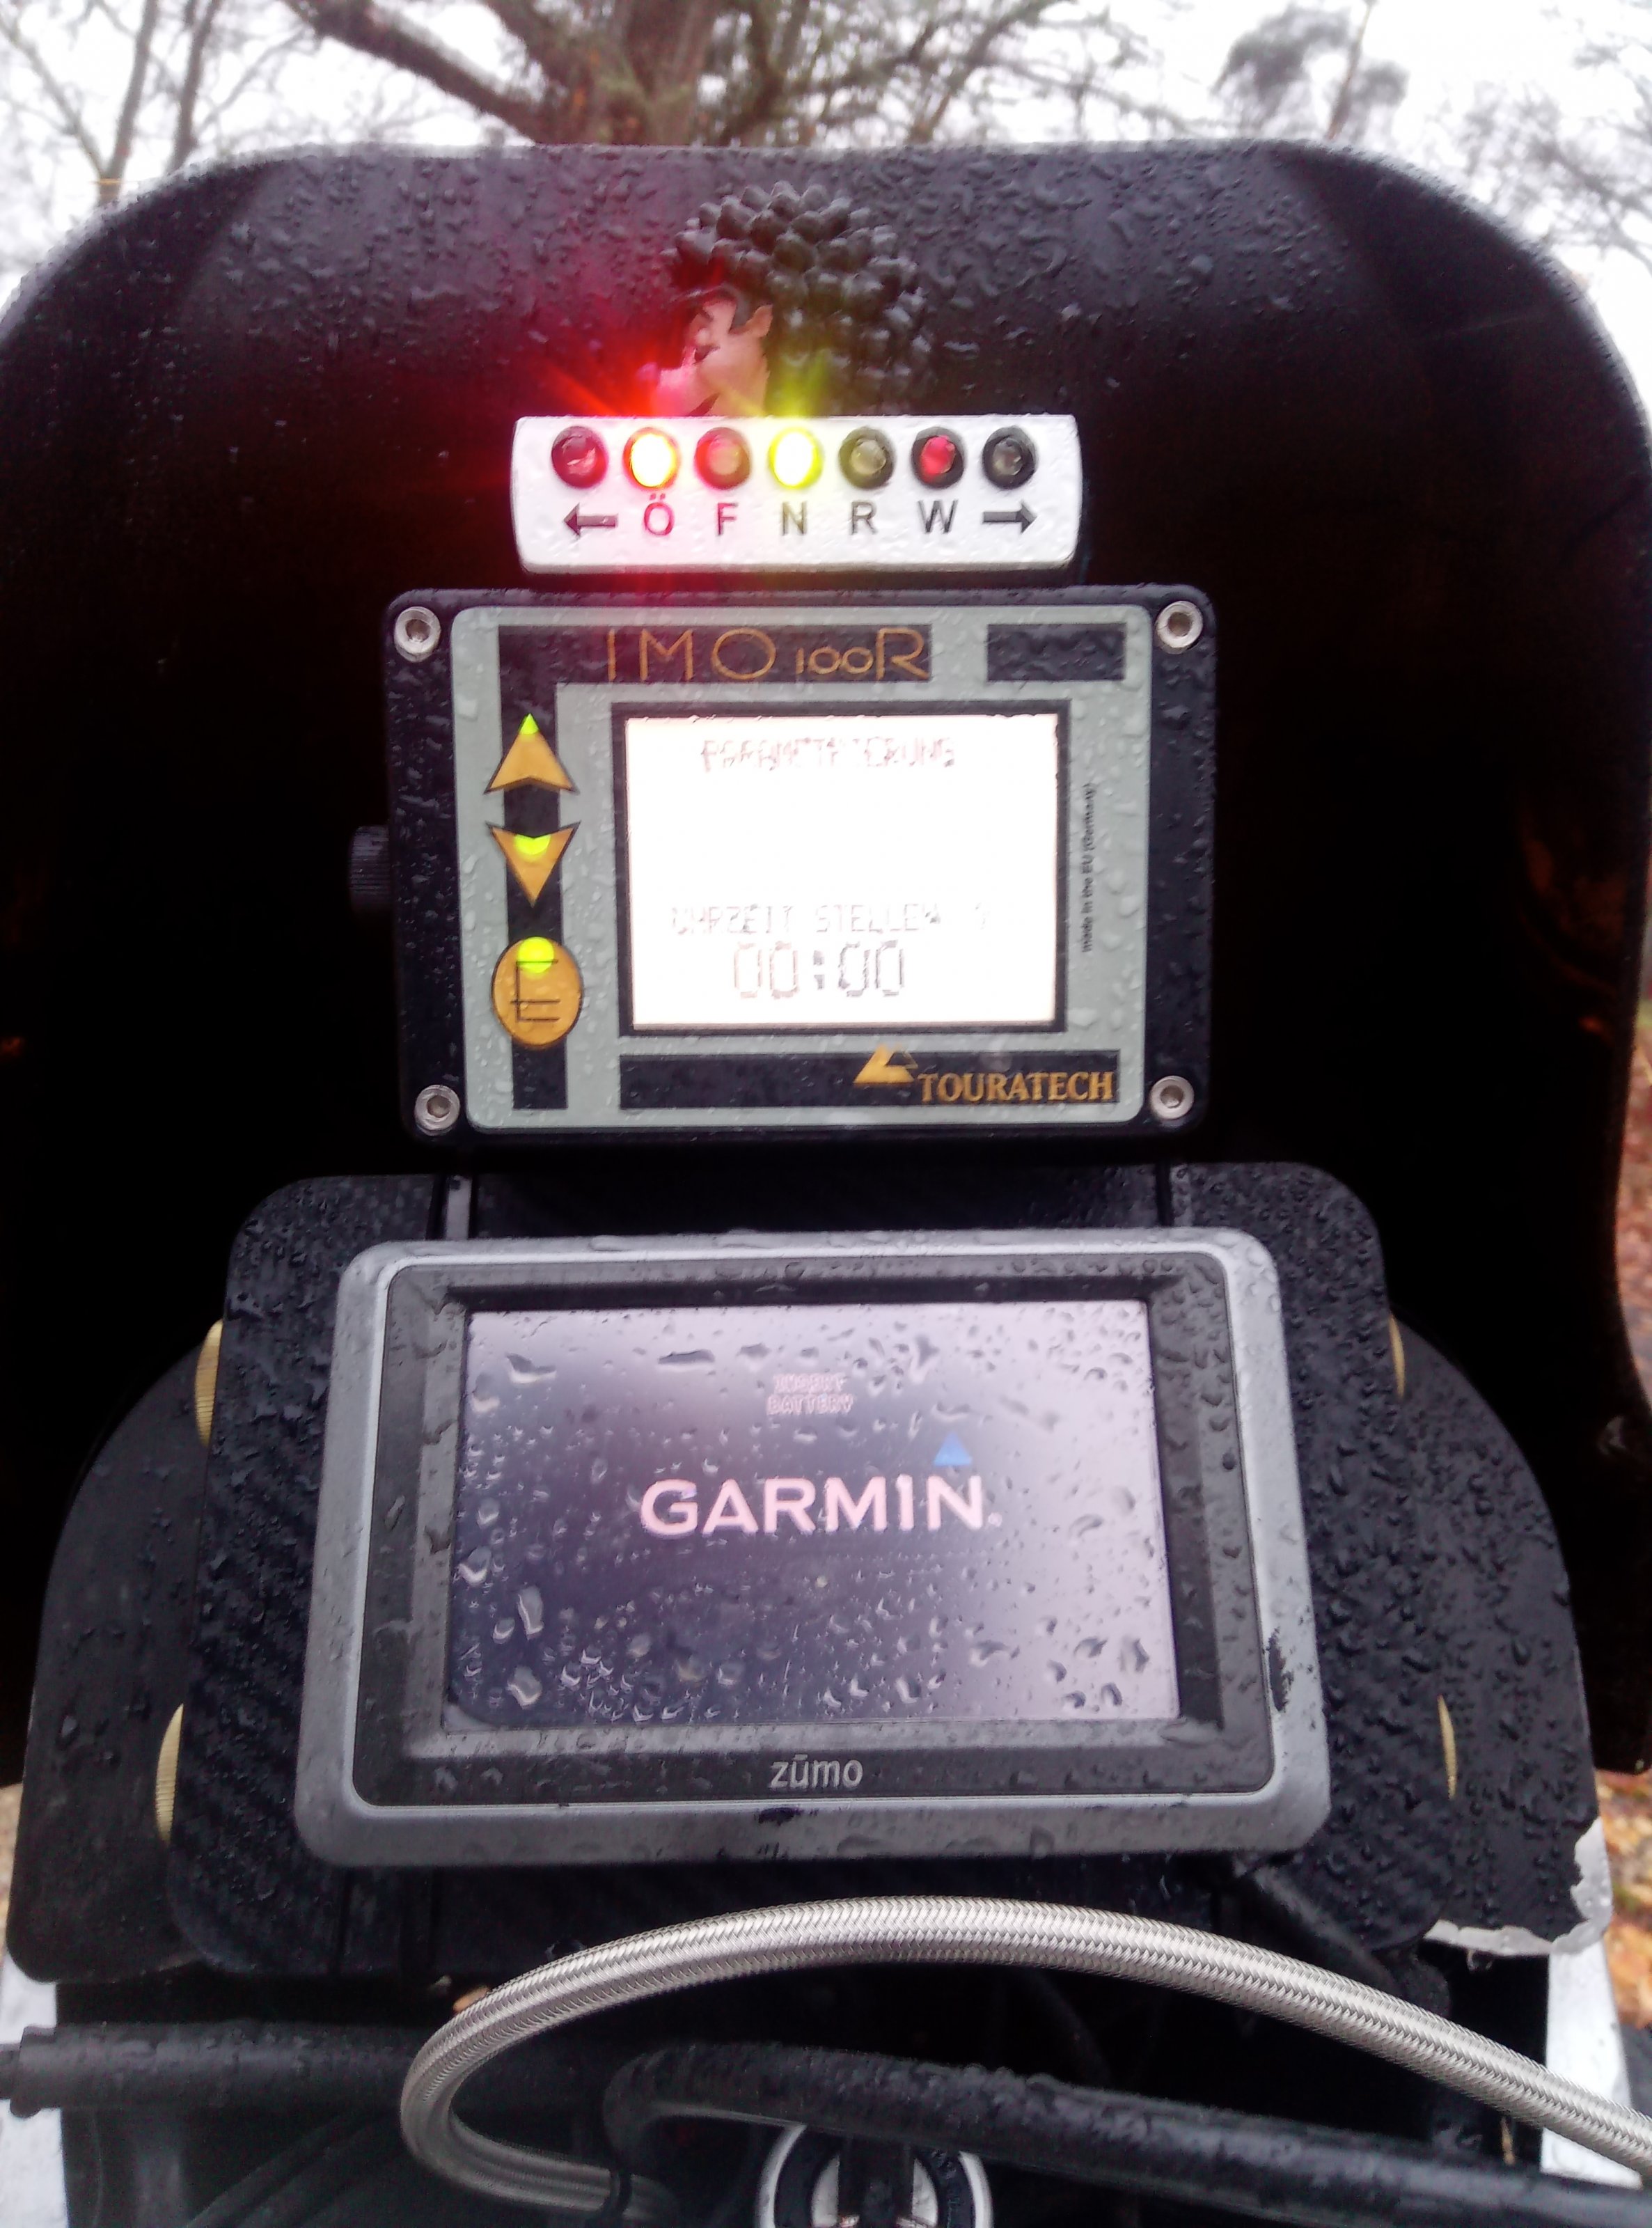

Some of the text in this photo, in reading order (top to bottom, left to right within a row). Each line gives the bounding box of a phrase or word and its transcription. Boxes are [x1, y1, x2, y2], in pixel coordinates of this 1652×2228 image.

[641, 492, 958, 537] Ö F N R W
[607, 627, 776, 681] IMO
[733, 939, 906, 999] 00:00
[918, 1071, 1115, 1103] TOURATECH
[640, 1474, 984, 1537] GARMIN
[770, 1753, 864, 1789] zūmo
